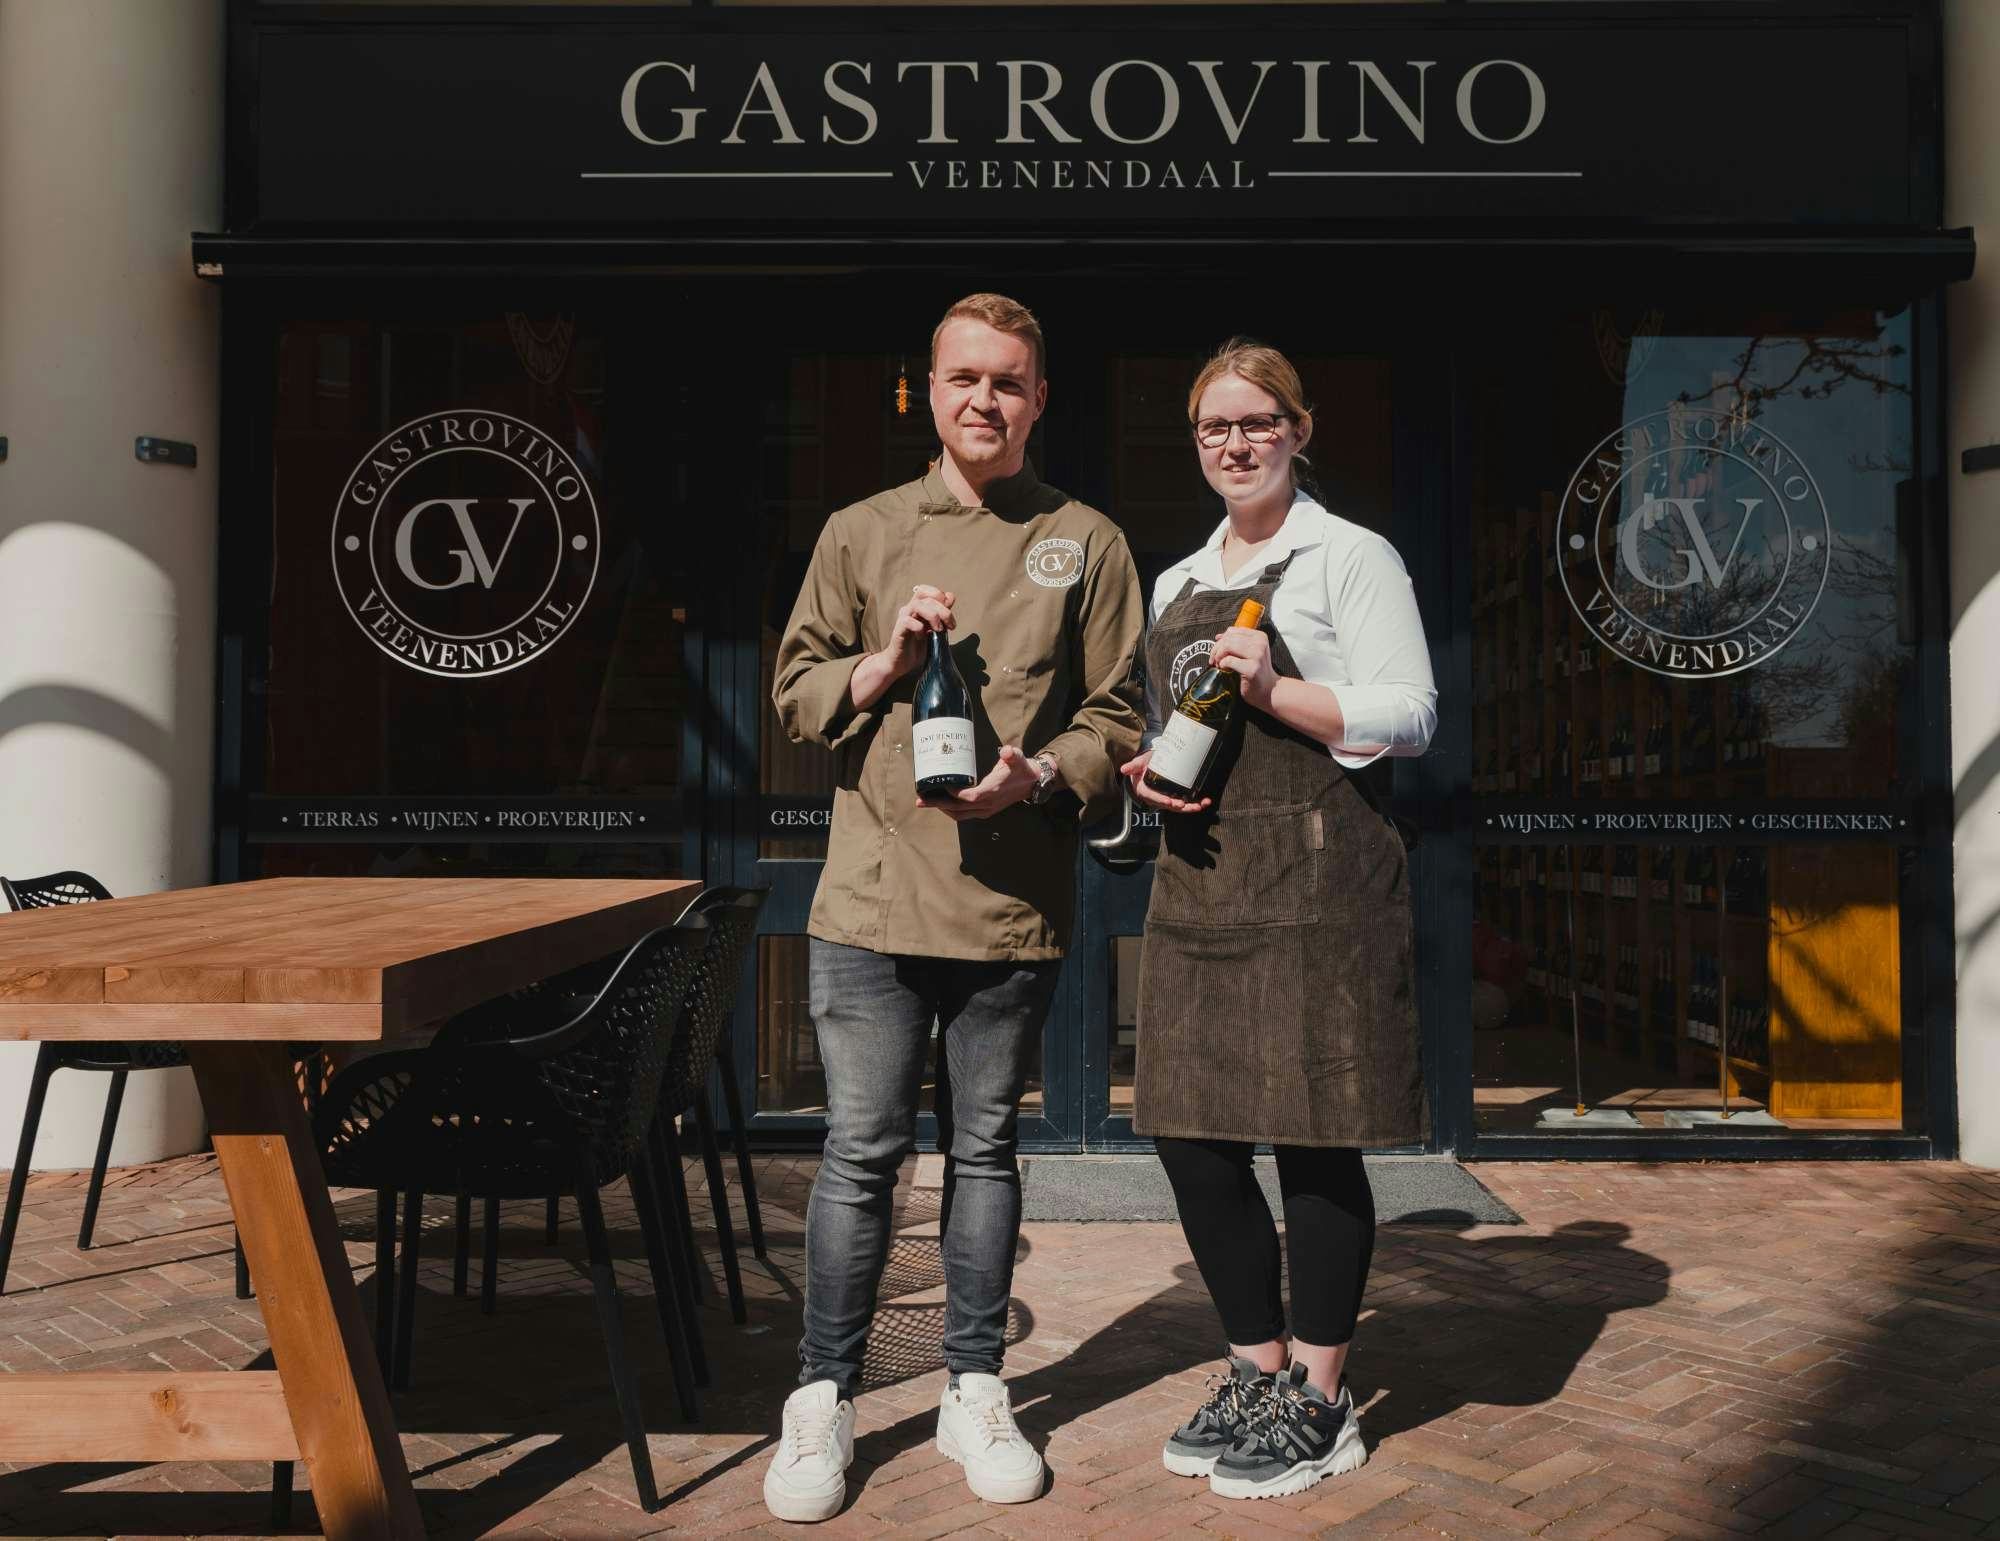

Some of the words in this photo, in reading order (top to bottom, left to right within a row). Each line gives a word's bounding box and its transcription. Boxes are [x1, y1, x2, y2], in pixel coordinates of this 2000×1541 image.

[620, 59, 1547, 146] GASTROVINO
[907, 160, 1256, 190] VEENENDAAL
[351, 417, 581, 506] GASTROVINO
[1576, 417, 1810, 504] GASTROVINO
[395, 498, 536, 590] GV
[1031, 540, 1081, 556] GASTROVINO
[1040, 553, 1073, 572] GV
[1621, 498, 1764, 590] GV
[358, 588, 574, 670] VEENENDAAL
[1584, 588, 1805, 671] VEENENDAAL
[299, 811, 379, 827] TERRAS
[403, 811, 478, 831] WIJNEN
[498, 811, 633, 831] PROEVERIJEN
[1498, 814, 1575, 833] WIJNEN
[1595, 814, 1732, 833] PROEVERIJEN
[1751, 814, 1894, 830] GESCHENKEN
